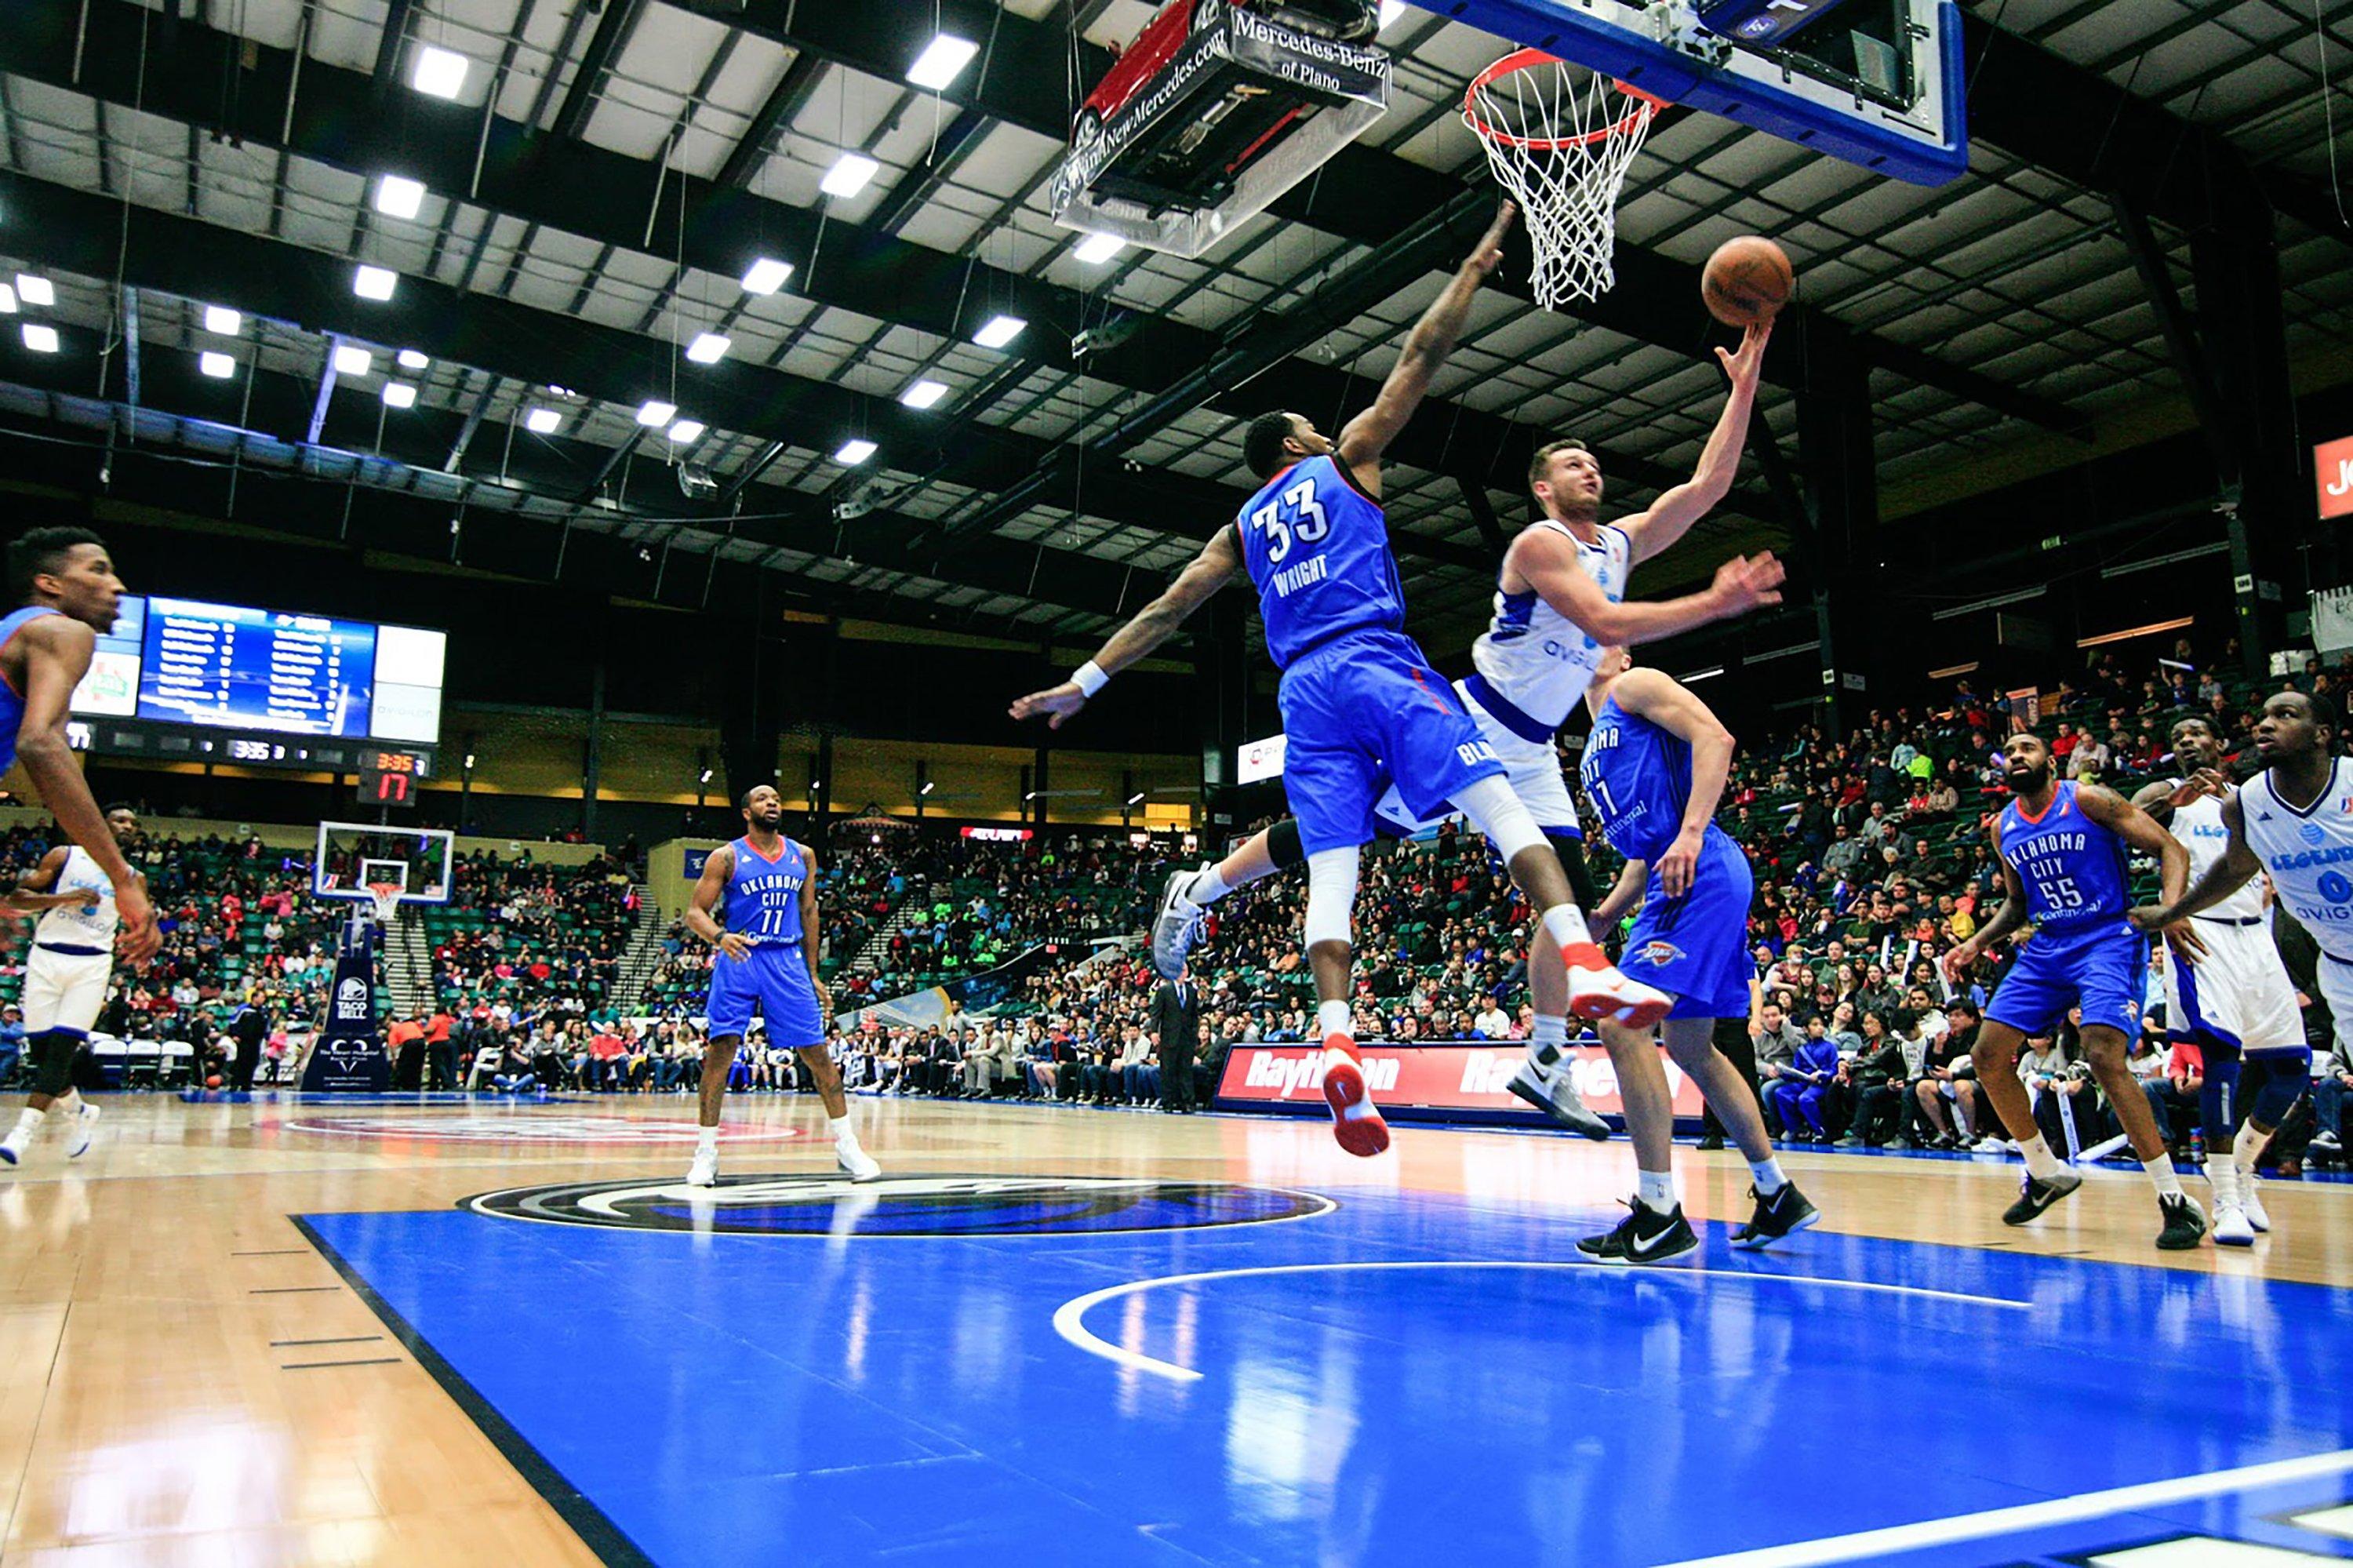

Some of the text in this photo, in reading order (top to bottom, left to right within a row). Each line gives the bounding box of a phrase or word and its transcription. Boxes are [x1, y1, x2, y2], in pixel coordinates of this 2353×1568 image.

[1235, 11, 1387, 78] Mercedes-Benz
[1281, 61, 1340, 92] of Plano
[1251, 477, 1329, 563] 33
[1272, 554, 1329, 598] WRIGHT
[376, 751, 413, 772] 3:35
[378, 772, 409, 801] 17
[2030, 857, 2063, 879] CITY
[740, 875, 804, 896] OKLAHOM
[762, 892, 789, 906] CITY
[2038, 877, 2083, 910] 55
[2317, 870, 2353, 904] 0
[336, 1001, 367, 1011] TACO
[337, 1010, 367, 1020] BELL
